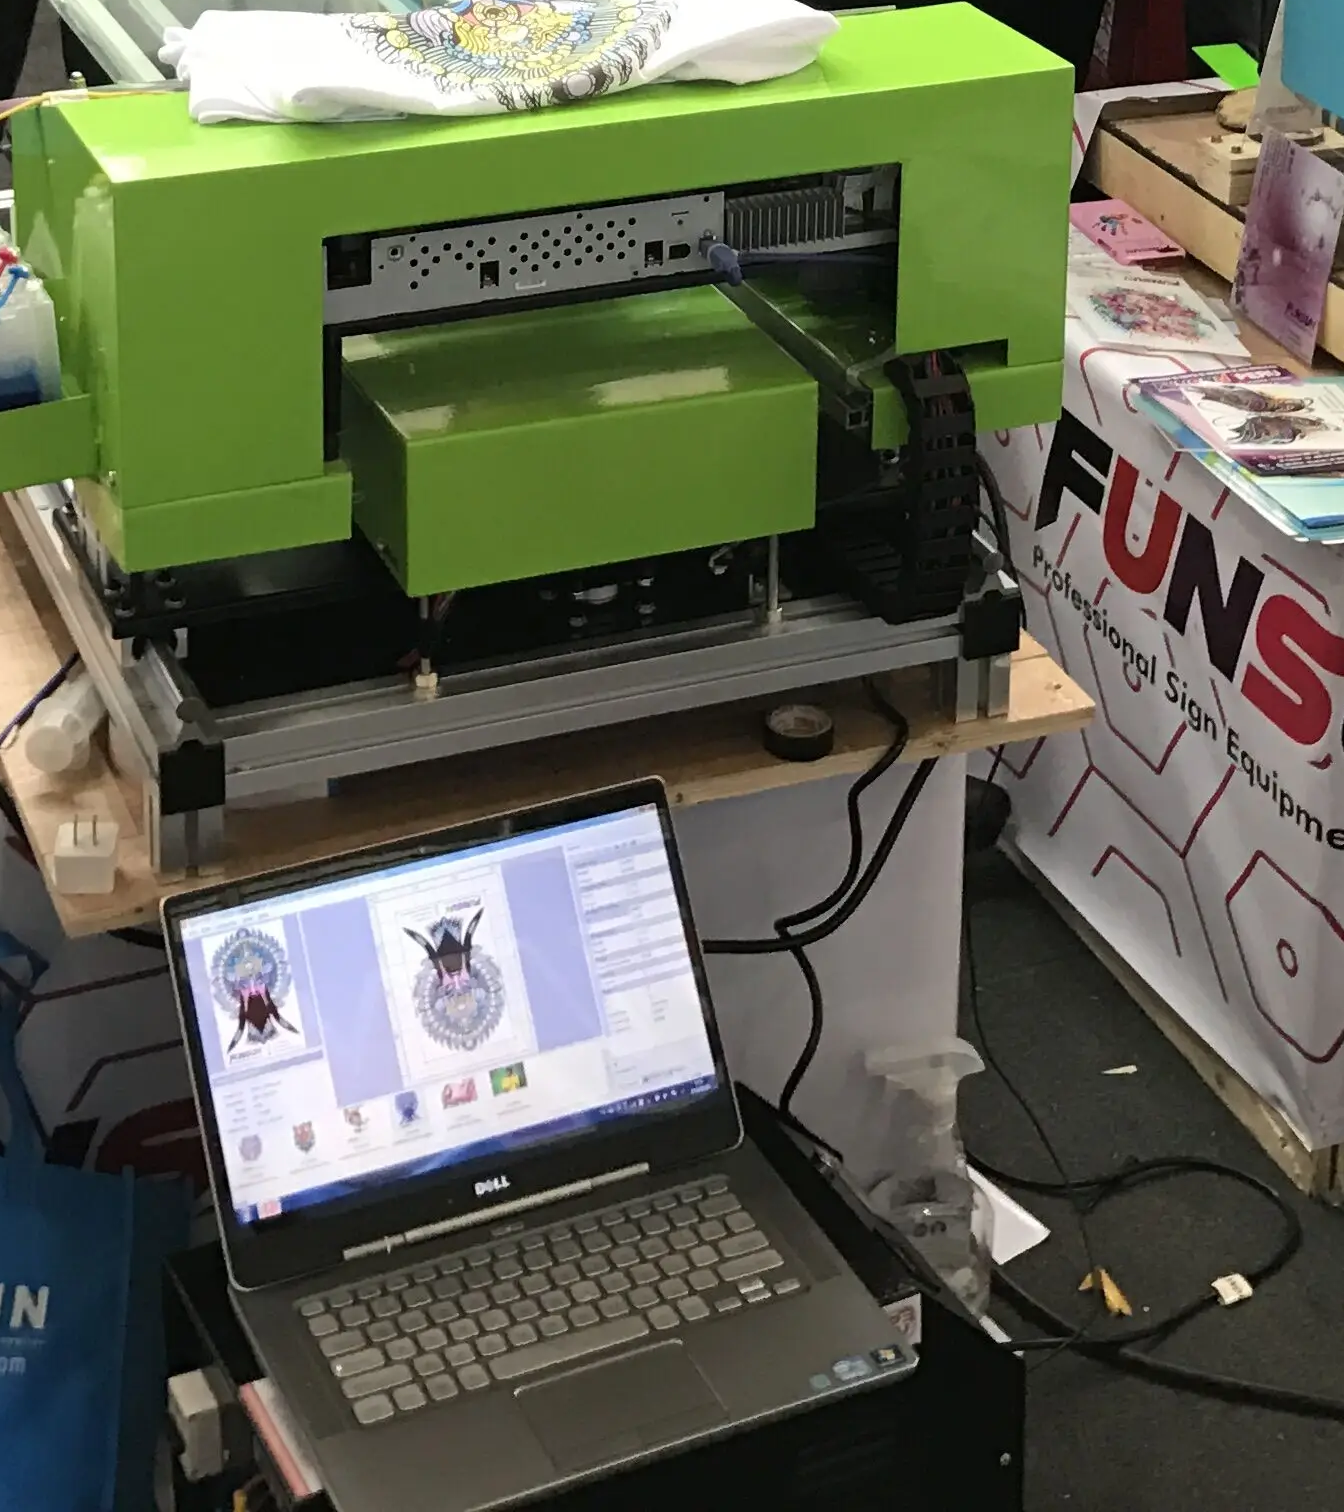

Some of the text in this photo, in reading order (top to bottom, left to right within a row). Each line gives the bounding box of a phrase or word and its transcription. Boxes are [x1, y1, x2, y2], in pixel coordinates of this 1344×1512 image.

[1033, 545, 1157, 685] Professional
[1164, 670, 1218, 742] Sign
[474, 1175, 512, 1196] DELL
